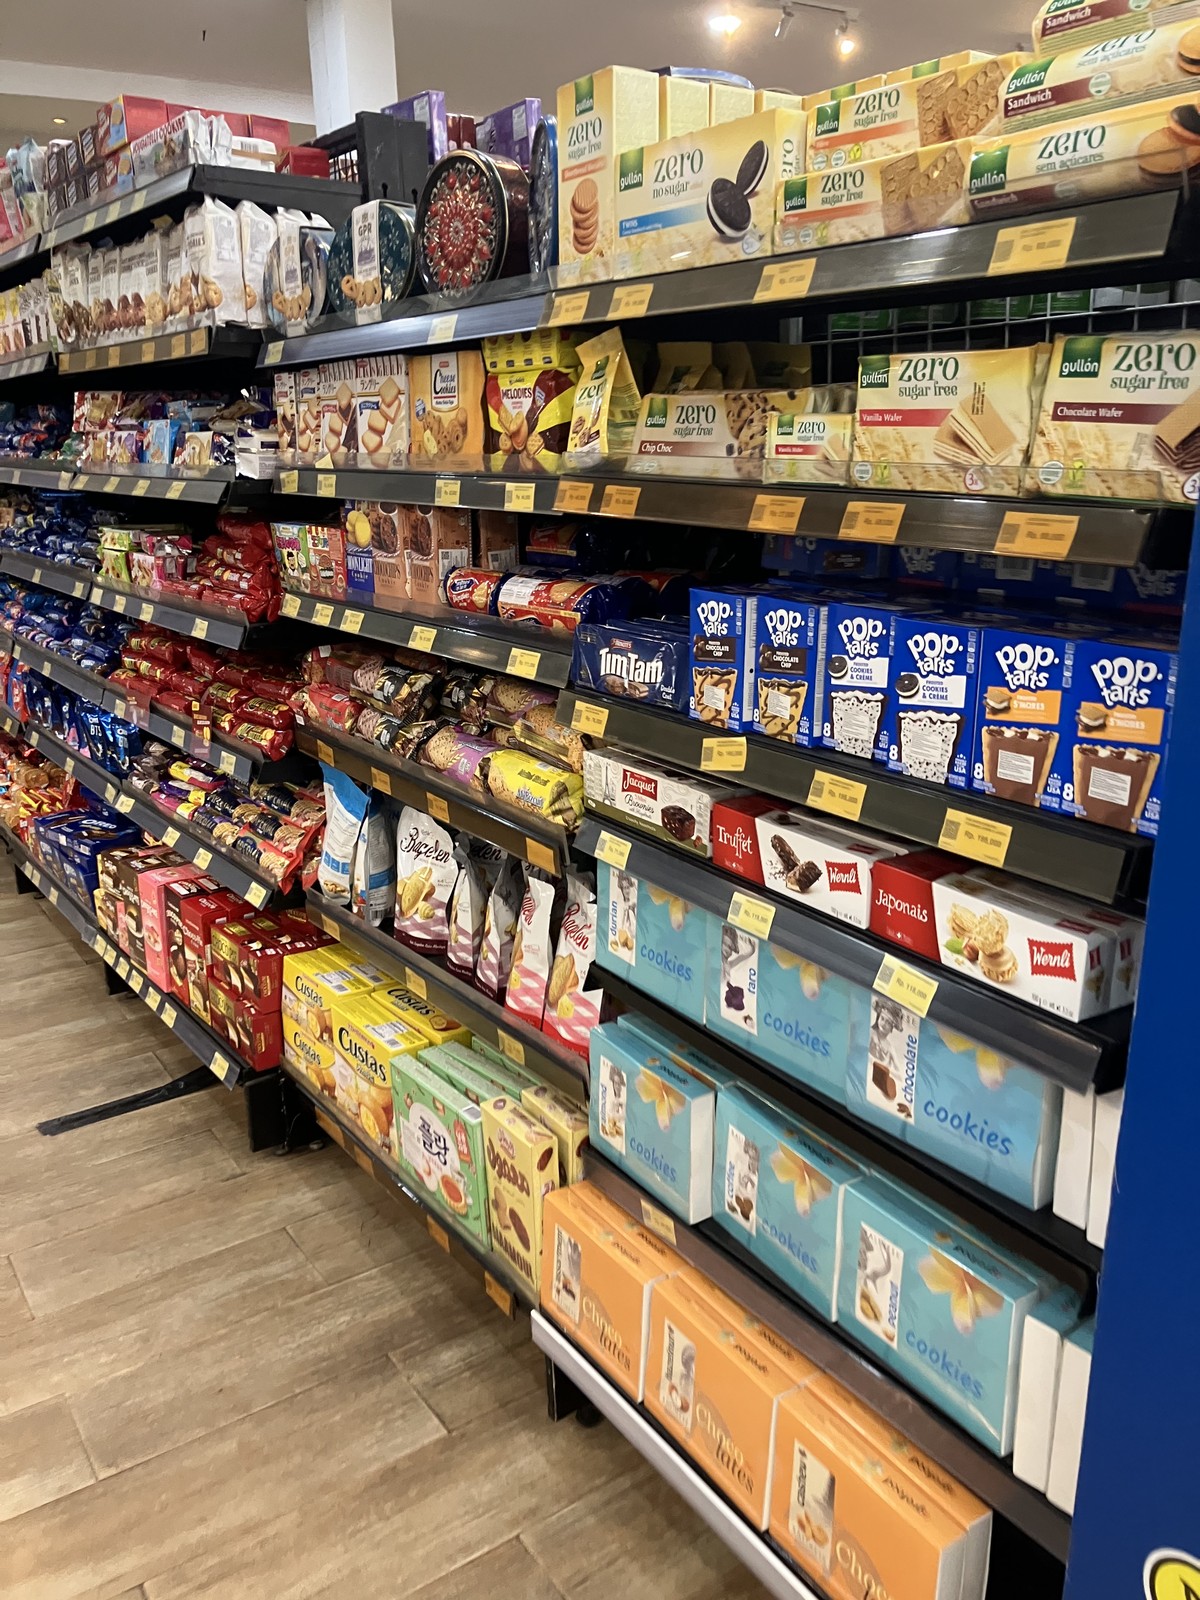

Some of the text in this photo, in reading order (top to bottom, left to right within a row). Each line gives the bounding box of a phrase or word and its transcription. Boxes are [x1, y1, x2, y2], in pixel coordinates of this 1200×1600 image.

[1046, 7, 1092, 28] Sandwich
[1008, 71, 1046, 91] gullón
[854, 88, 900, 116] zero
[1007, 89, 1052, 110] Sandwich
[816, 120, 839, 133] gullón
[853, 109, 898, 128] sugar free
[567, 116, 603, 148] zero
[1037, 125, 1107, 160] zero
[653, 148, 704, 183] zero
[781, 138, 795, 178] ero
[1036, 151, 1105, 174] sem açúcares
[620, 172, 643, 190] gullón
[652, 181, 690, 199] no sugar
[821, 169, 865, 194] zero
[785, 196, 806, 211] gullón
[821, 189, 864, 206] sugar free
[1061, 358, 1099, 376] gullón
[1112, 342, 1197, 373] zero
[897, 356, 960, 383] zero
[898, 383, 959, 400] sugar free
[1110, 372, 1190, 392] sugar free
[502, 386, 532, 400] MELODIES
[646, 414, 667, 427] gullón
[676, 404, 716, 425] zero
[862, 412, 903, 423] Vanilla Wafer
[1057, 406, 1124, 419] Chocolate Wafer
[673, 423, 714, 439] sugar free
[797, 420, 826, 434] zero
[641, 442, 673, 454] Chip Choc
[703, 621, 729, 637] tarts
[770, 630, 799, 648] tarts
[705, 644, 730, 652] CHOCOLATE
[712, 649, 723, 657] CHIP
[845, 639, 880, 658] tarts
[772, 655, 799, 663] CHOCOLATE
[780, 661, 792, 669] CHIP
[916, 657, 956, 676] tarts
[850, 666, 873, 675] COOKIES
[1004, 668, 1049, 690] tarts
[922, 684, 949, 694] COOKIES
[1100, 683, 1152, 707] tarts
[689, 696, 696, 709] 8
[753, 708, 760, 722] 8
[823, 722, 831, 736] 8
[889, 744, 899, 760] 8
[953, 765, 967, 775] USA
[973, 762, 984, 780] 8
[622, 771, 656, 795] Jacquet
[1046, 785, 1061, 796] USA
[1062, 782, 1074, 801] 8
[624, 793, 655, 814] Brownies
[81, 819, 117, 829] OREO
[1144, 809, 1160, 820] USA
[400, 827, 451, 863] Bagelen
[717, 823, 753, 859] Truffet
[828, 866, 857, 884] Wernli
[875, 888, 928, 923] Japonais
[610, 901, 618, 937] durian
[640, 943, 693, 982] cookies
[1032, 945, 1071, 969] Wernli
[295, 975, 323, 1008] Custas
[748, 967, 757, 995] taro
[386, 986, 435, 1017] Custas
[763, 1012, 831, 1058] cookies
[293, 1031, 321, 1066] Custas
[338, 1026, 387, 1083] Custas
[901, 1034, 918, 1104] chocolate
[923, 1100, 1013, 1156] cookies
[419, 1114, 449, 1166] 플랑
[629, 1137, 677, 1183] cookies
[727, 1161, 735, 1198] coffee
[761, 1218, 818, 1274] cookies
[888, 1280, 899, 1330] peanut
[582, 1295, 623, 1348] Choco
[600, 1327, 631, 1372] lates
[905, 1329, 984, 1401] cookies
[696, 1402, 744, 1466] Choco
[715, 1438, 754, 1497] lates
